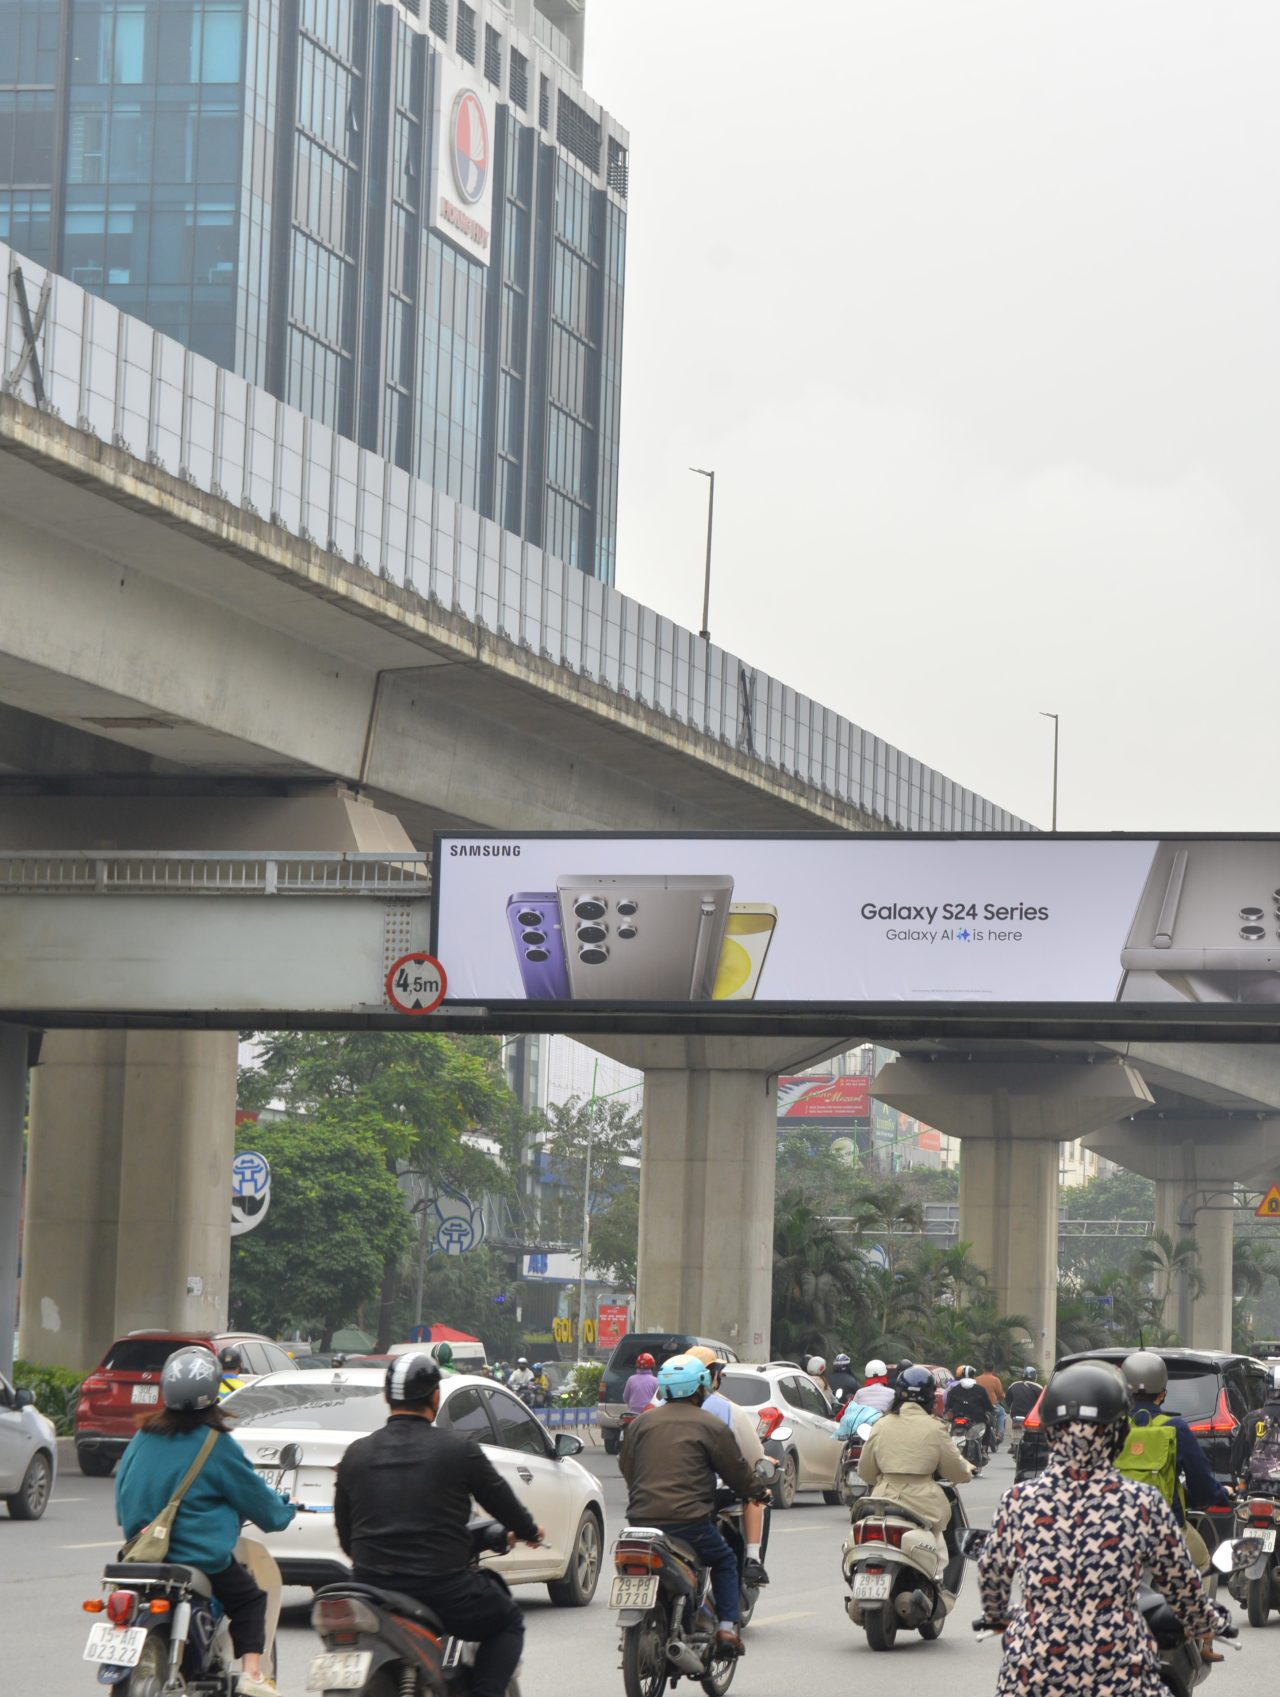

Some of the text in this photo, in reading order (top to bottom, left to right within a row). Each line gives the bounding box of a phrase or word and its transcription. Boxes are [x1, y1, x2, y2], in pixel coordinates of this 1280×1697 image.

[450, 845, 521, 857] SAMSUNG
[861, 902, 1049, 925] Galaxy S24 Series
[886, 928, 1022, 944] Galaxy AI is here
[397, 968, 439, 994] 4,5m
[618, 1578, 651, 1591] 29-P9
[616, 1592, 648, 1605] 0720
[88, 1642, 137, 1663] 023.22
